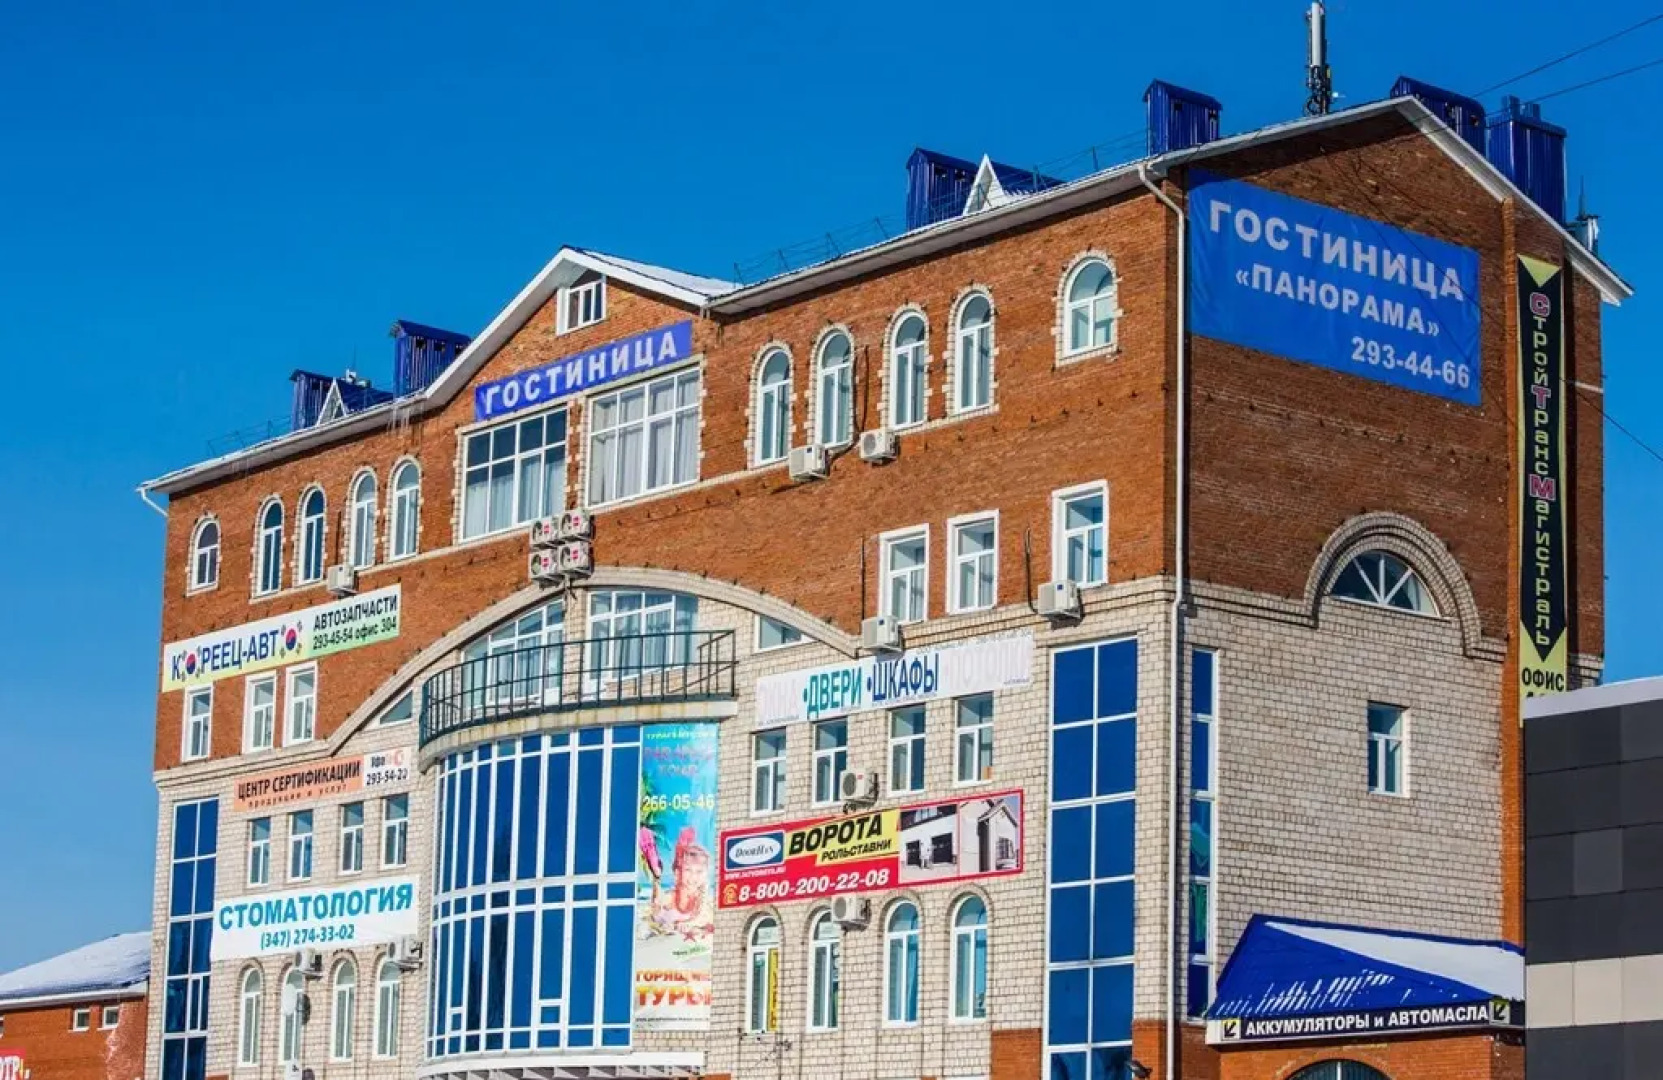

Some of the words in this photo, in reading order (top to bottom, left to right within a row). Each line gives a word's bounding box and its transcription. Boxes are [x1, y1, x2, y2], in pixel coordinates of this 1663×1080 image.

[1208, 199, 1465, 302] ГОСТИНИЦА
[1235, 263, 1440, 338] «ПАНОРАМА»
[485, 331, 678, 415] ГОСТИНИЦА
[1351, 336, 1470, 389] 293-44-66
[313, 594, 397, 632] АВТОЗАПЧАСТИ
[355, 624, 379, 642] офис
[807, 666, 862, 720] ДВЕРИ
[872, 653, 939, 702] ШКАФЫ
[1521, 667, 1565, 692] ОФИС
[238, 779, 271, 801] ЦЕНТР
[272, 761, 360, 792] СЕРТИФИКАЦИИ
[642, 793, 715, 812] 266-05-46
[788, 814, 883, 857] ВОРОТА
[821, 838, 892, 862] РОЛЬСТАВНИ
[738, 867, 890, 903] 8-800-200-22-08
[219, 882, 414, 931] СТОМАТОЛОГИЯ
[260, 929, 291, 951] (347)
[294, 924, 355, 945] 274-33-02
[637, 986, 712, 1006] ТУРЫ
[1245, 1013, 1370, 1037] АККУМУЛЯТОРЫ
[1388, 1004, 1490, 1027] АВТОМАСЛА
